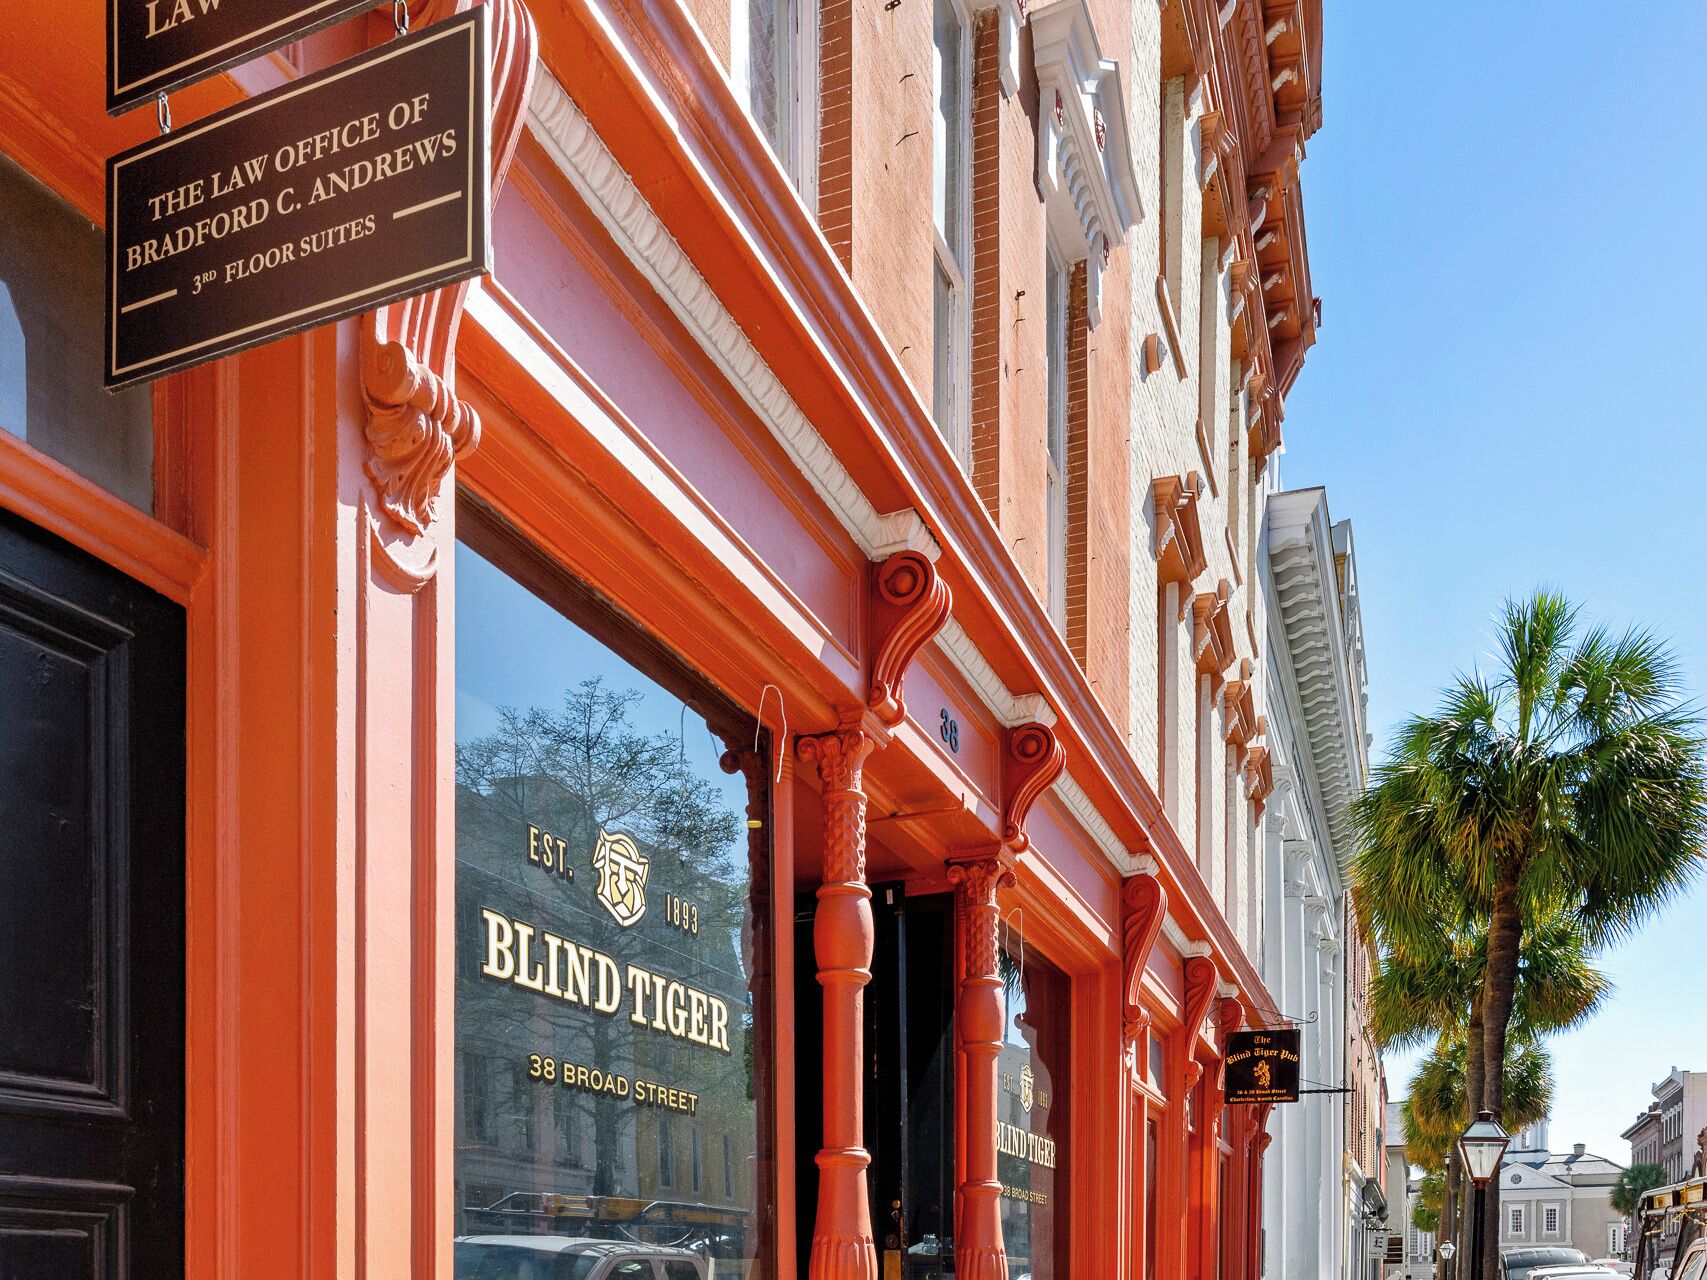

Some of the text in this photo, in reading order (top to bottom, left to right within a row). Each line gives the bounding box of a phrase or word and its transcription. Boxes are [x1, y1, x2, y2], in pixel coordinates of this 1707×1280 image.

[148, 93, 429, 221] THE LAW OFFICE OF
[126, 129, 457, 272] BRADFORD C. ANDREWS
[192, 214, 376, 295] 3RD FLOOR SUITES
[941, 708, 959, 753] 38
[528, 823, 699, 934] EST. 1893
[482, 907, 731, 1053] BLIND TIGER
[1226, 1047, 1299, 1065] Blind Tiger Pub
[1254, 1035, 1271, 1045] The
[528, 1053, 699, 1113] 38 BROAD STREET
[1027, 1132, 1056, 1168] TIGER
[1003, 1185, 1048, 1205] 38 BROAD STREET
